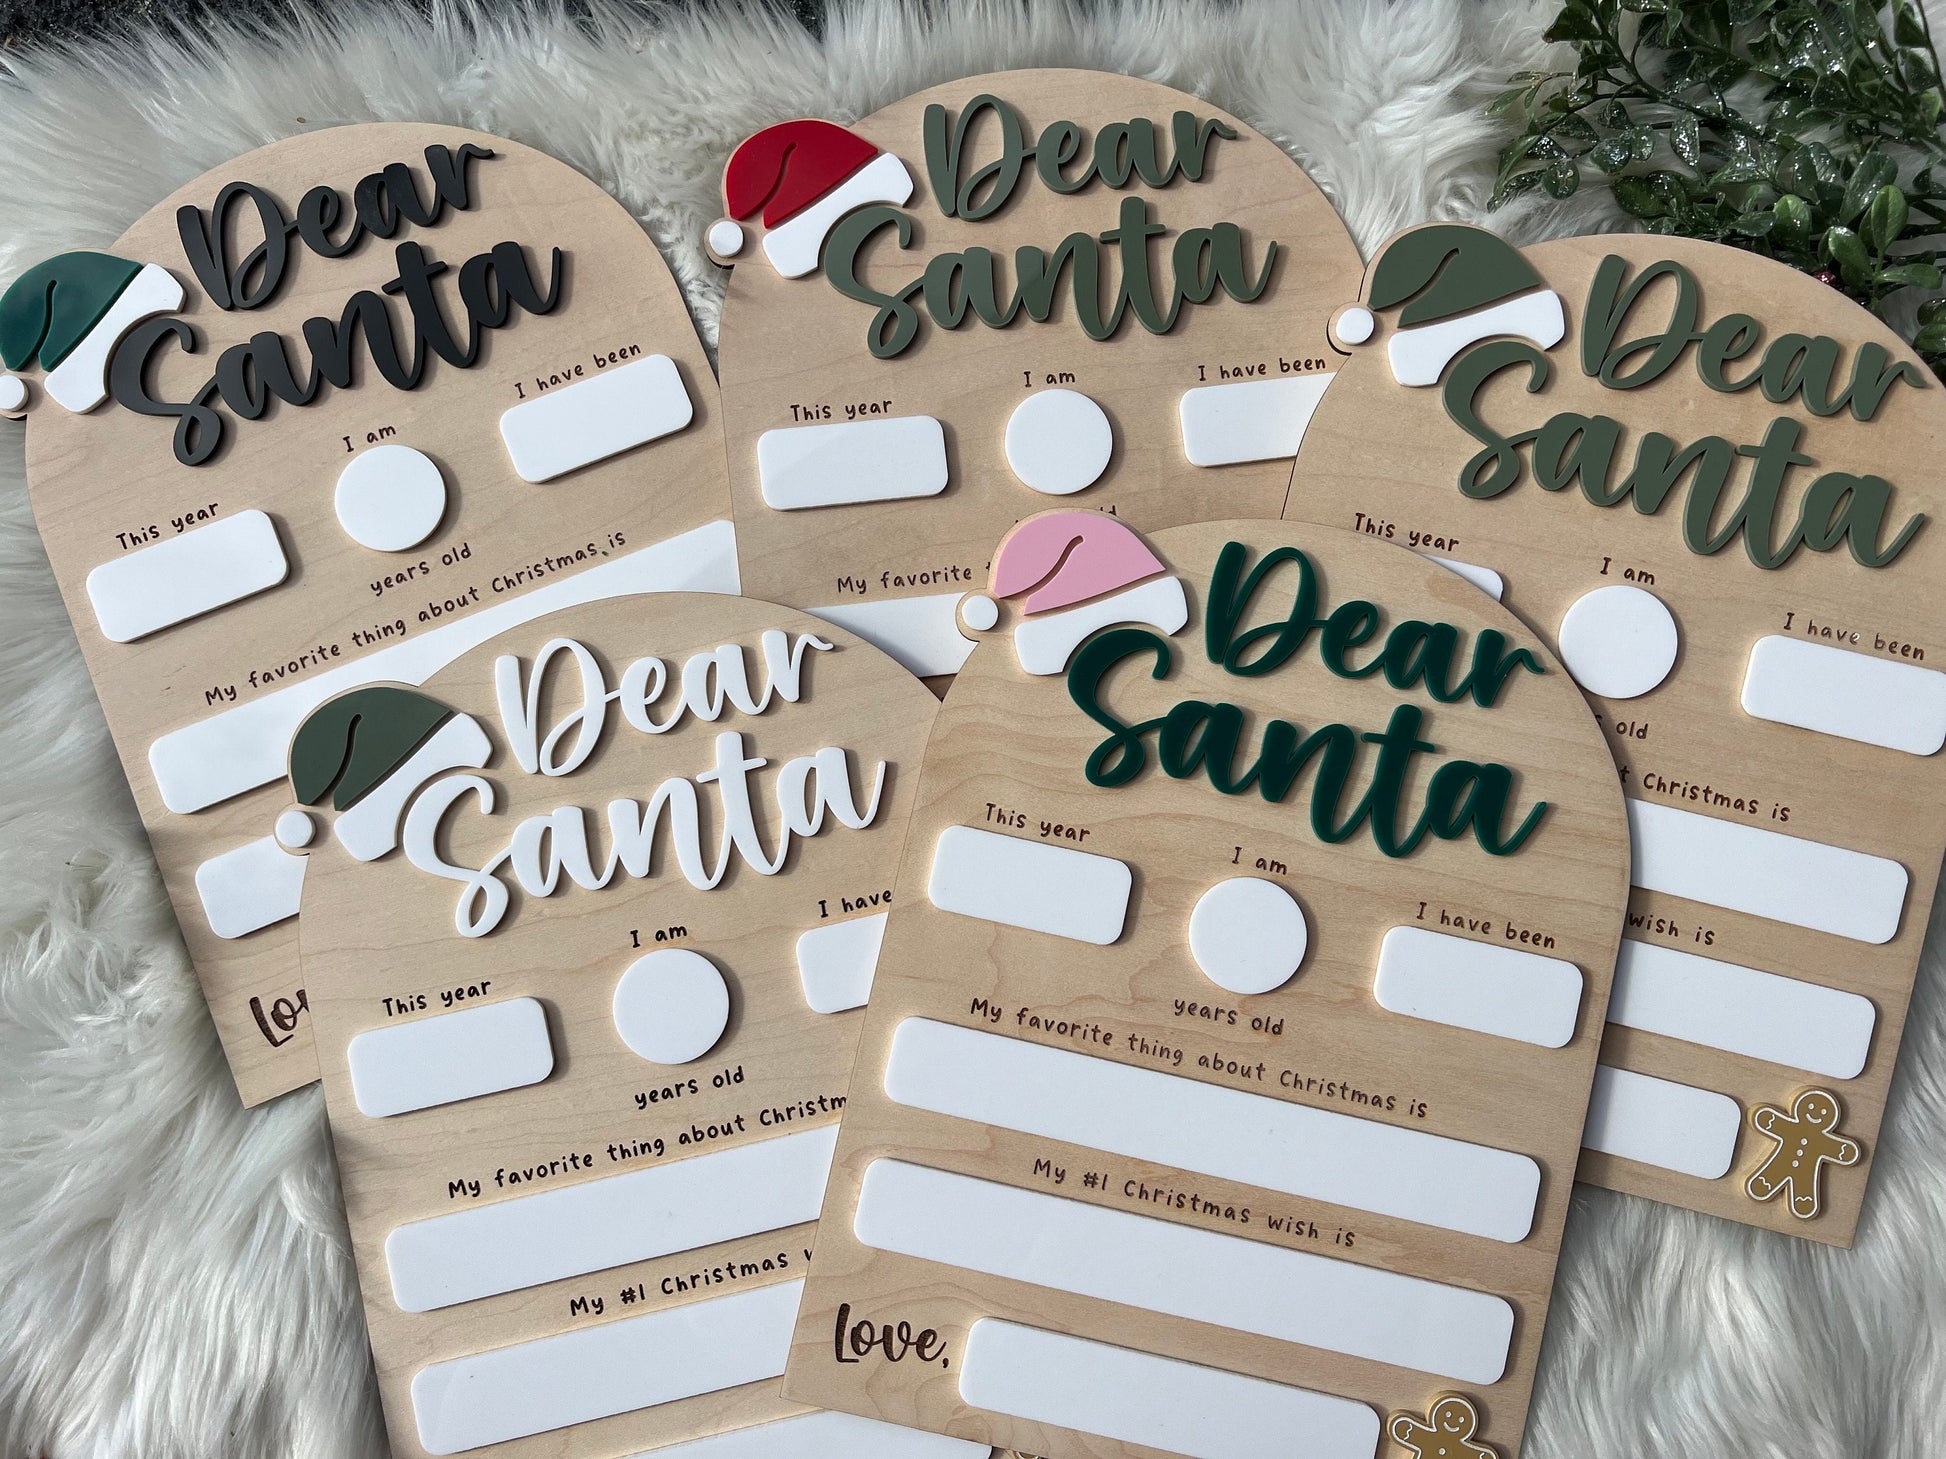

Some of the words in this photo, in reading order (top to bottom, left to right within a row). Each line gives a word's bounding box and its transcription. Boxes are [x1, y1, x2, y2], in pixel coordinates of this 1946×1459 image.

[924, 94, 1238, 222] Dear
[177, 144, 495, 311] Dear
[825, 197, 1277, 359] Santa
[107, 241, 561, 466] Santa
[1582, 254, 1927, 421] Dear
[514, 382, 526, 400] I
[535, 364, 584, 391] have
[592, 344, 641, 369] been
[1023, 370, 1032, 388] I
[1045, 372, 1076, 385] am
[1197, 364, 1207, 382] I
[1219, 363, 1267, 380] have
[1278, 357, 1326, 374] been
[789, 404, 832, 422] This
[844, 400, 893, 421] year
[342, 435, 355, 453] I
[366, 425, 397, 444] am
[1442, 340, 1926, 570] Santa
[115, 525, 160, 550] This
[171, 502, 219, 534] year
[1355, 512, 1396, 539] This
[1408, 530, 1460, 552] year
[370, 561, 430, 597] years
[441, 542, 472, 566] old
[837, 575, 867, 595] My
[880, 564, 972, 589] favorite
[1599, 556, 1612, 576] I
[1623, 567, 1655, 586] am
[205, 685, 237, 706] My
[248, 644, 341, 689] favorite
[351, 619, 407, 647] thing
[418, 586, 480, 623] about
[491, 542, 598, 593] Christmas
[607, 532, 626, 549] is
[1204, 540, 1545, 707] Dear
[1783, 611, 1795, 631] I
[1807, 619, 1858, 646] have
[1873, 632, 1925, 661] been
[495, 629, 833, 778] Dear
[1067, 628, 1548, 858] Santa
[1615, 720, 1649, 740] old
[1643, 772, 1759, 815] Christmas
[1771, 802, 1791, 822] is
[403, 731, 885, 938] Santa
[985, 802, 1027, 829] This
[1040, 820, 1091, 847] year
[1231, 846, 1243, 865] I
[1255, 857, 1288, 876] am
[817, 899, 829, 919] I
[841, 889, 893, 913] have
[1416, 901, 1428, 921] I
[1439, 909, 1492, 935] have
[1505, 921, 1555, 950] been
[1628, 912, 1679, 937] wish
[1694, 926, 1715, 946] is
[629, 929, 641, 949] I
[654, 925, 688, 942] am
[381, 994, 427, 1017] This
[440, 981, 492, 1008] year
[1174, 998, 1238, 1026] years
[1251, 1015, 1285, 1036] old
[970, 997, 1002, 1024] My
[1016, 1007, 1113, 1047] favorite
[1127, 1032, 1184, 1067] thing
[1198, 1052, 1266, 1082] about
[1279, 1069, 1397, 1113] Christmas
[1409, 1098, 1428, 1119] is
[634, 1078, 699, 1111] years
[712, 1065, 745, 1089] old
[448, 1178, 481, 1199] My
[494, 1152, 593, 1188] favorite
[606, 1138, 665, 1162] thing
[678, 1114, 746, 1145] about
[1033, 1158, 1066, 1185] My
[1083, 1171, 1108, 1191] #1
[1124, 1179, 1251, 1225] Christmas
[1267, 1214, 1319, 1240] wish
[1335, 1227, 1356, 1248] is
[570, 1295, 604, 1317] My
[619, 1283, 646, 1305] #1
[660, 1252, 789, 1295] Christmas
[834, 1302, 949, 1369] Love,
